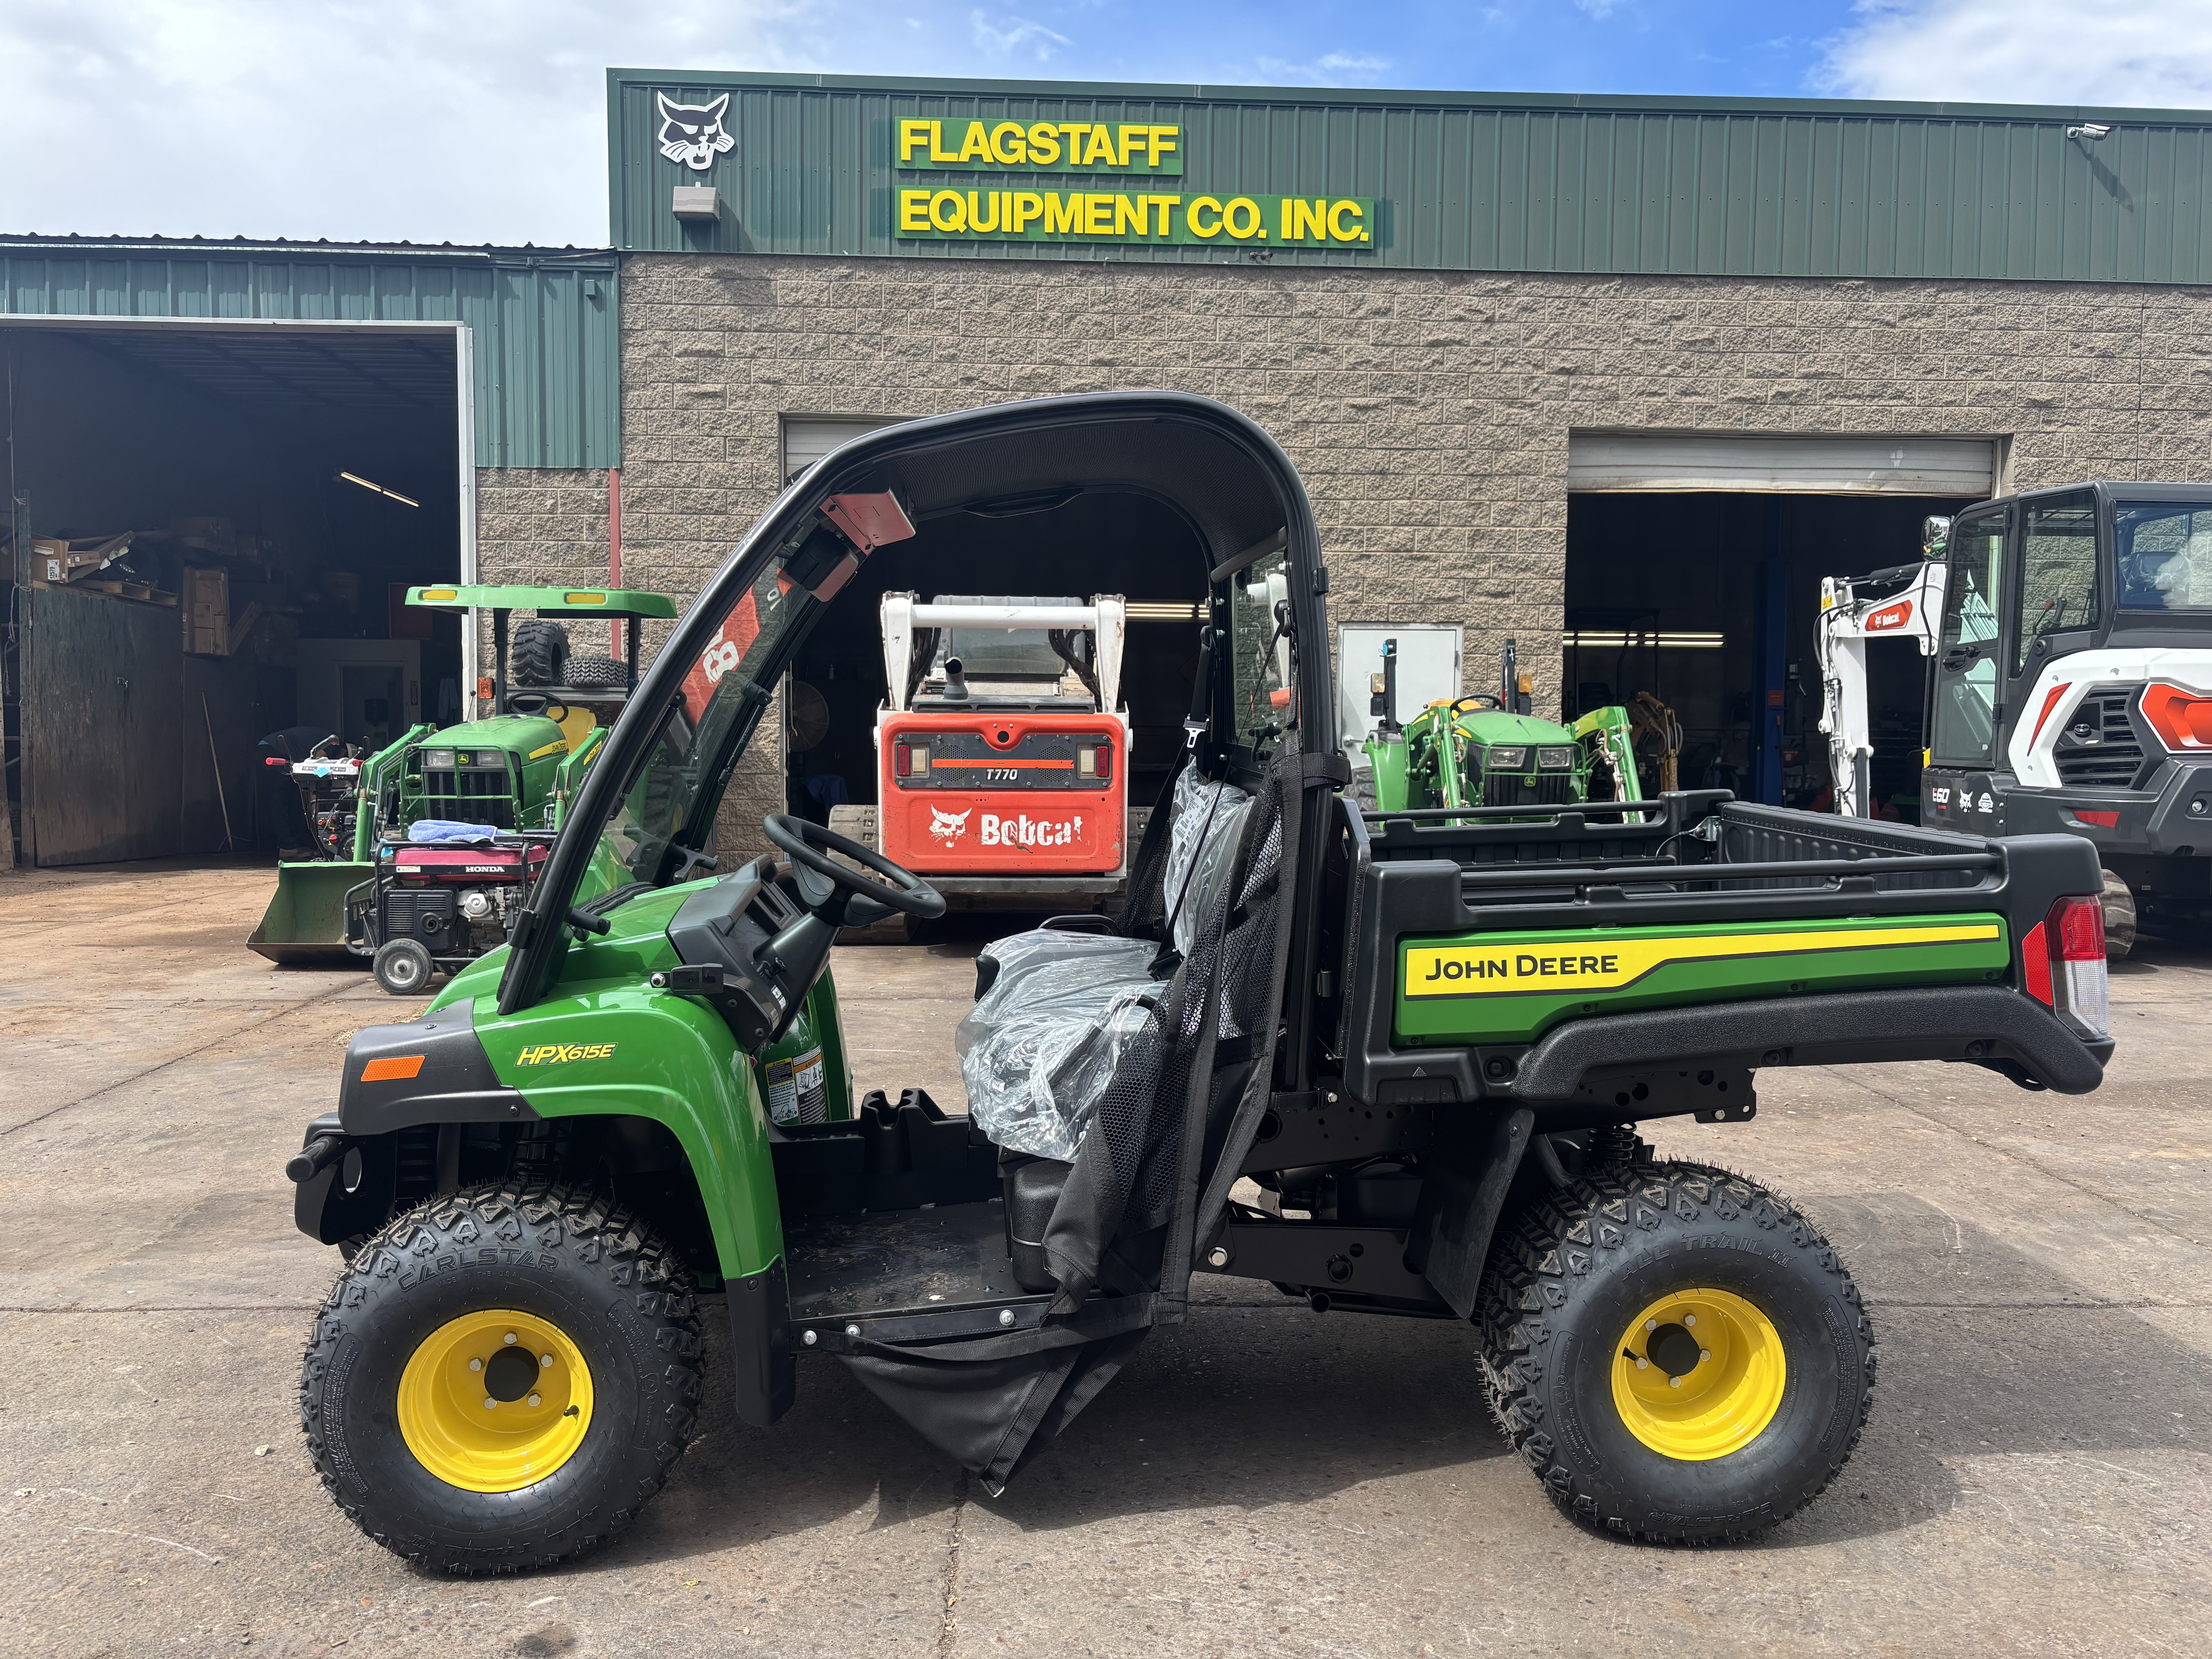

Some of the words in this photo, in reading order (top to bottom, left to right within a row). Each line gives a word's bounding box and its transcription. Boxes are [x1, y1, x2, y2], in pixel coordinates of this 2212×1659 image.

[900, 120, 1179, 167] FLAGSTAFF
[900, 190, 1180, 236] EQUIPMENT
[1187, 196, 1267, 239] CO.
[1281, 198, 1369, 242] INC.
[1882, 612, 1899, 626] Bobcat
[987, 769, 1018, 780] T770
[1932, 787, 1950, 804] E60
[981, 814, 1083, 846] Bobcat
[1425, 958, 1508, 980] JOHN
[1516, 955, 1618, 977] DEERE
[516, 1044, 616, 1065] HPX615E
[397, 1247, 559, 1292] CARLSTAR
[1620, 1245, 1670, 1281] ALL
[1680, 1233, 1763, 1256] TRAIL
[1767, 1248, 1794, 1268] II
[436, 1276, 457, 1288] MADE
[1648, 1501, 1774, 1528] CARLSTAR
